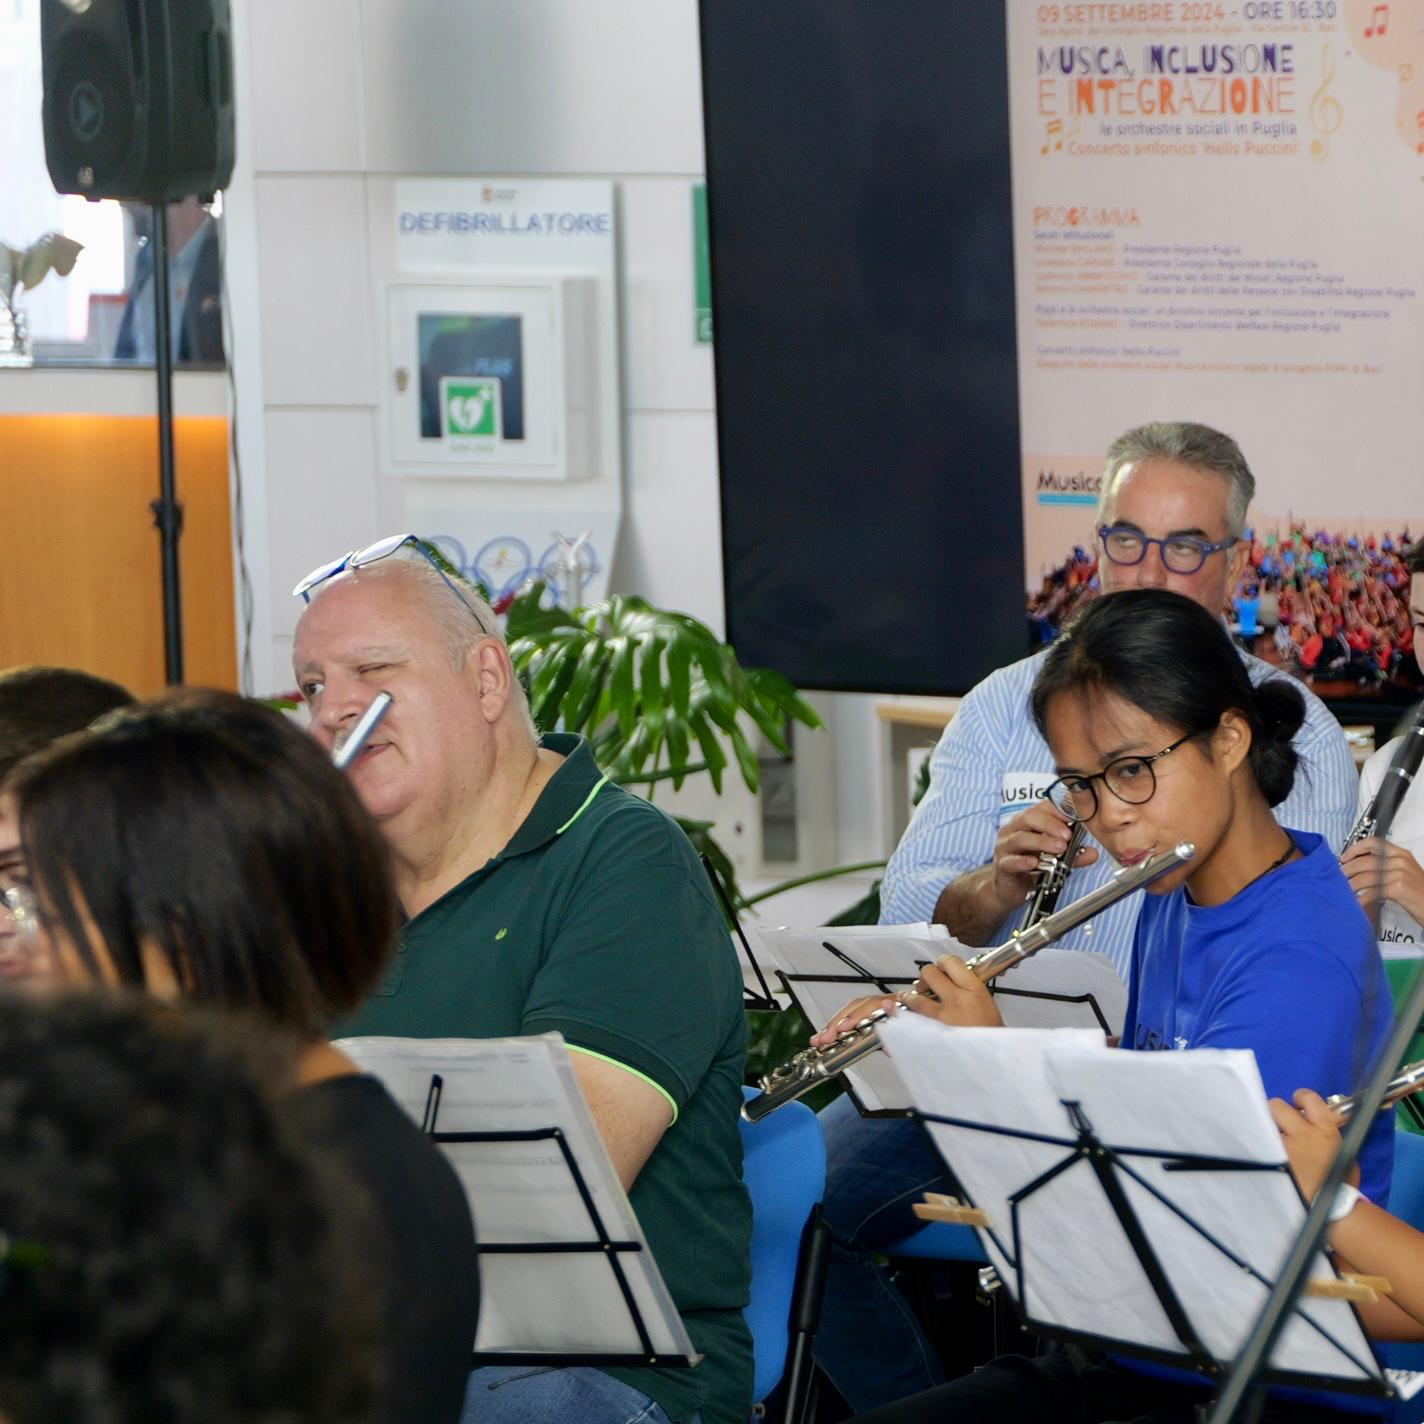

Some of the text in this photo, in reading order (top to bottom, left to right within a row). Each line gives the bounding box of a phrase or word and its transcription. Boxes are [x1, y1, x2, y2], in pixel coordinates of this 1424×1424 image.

[1037, 3, 1059, 22] 09
[1063, 3, 1174, 21] SETTEMBRE
[1181, 2, 1225, 20] 2024
[1243, 1, 1283, 20] ORE
[1289, 0, 1337, 19] 16:30
[1037, 43, 1294, 76] MUSICA, INCLUSIONE
[1039, 76, 1296, 115] E INTEGRAZIONE
[1117, 121, 1183, 137] orchestre
[1187, 120, 1231, 137] sociali
[1252, 119, 1298, 138] Puglia
[400, 212, 610, 233] DEFIBRILLATORE
